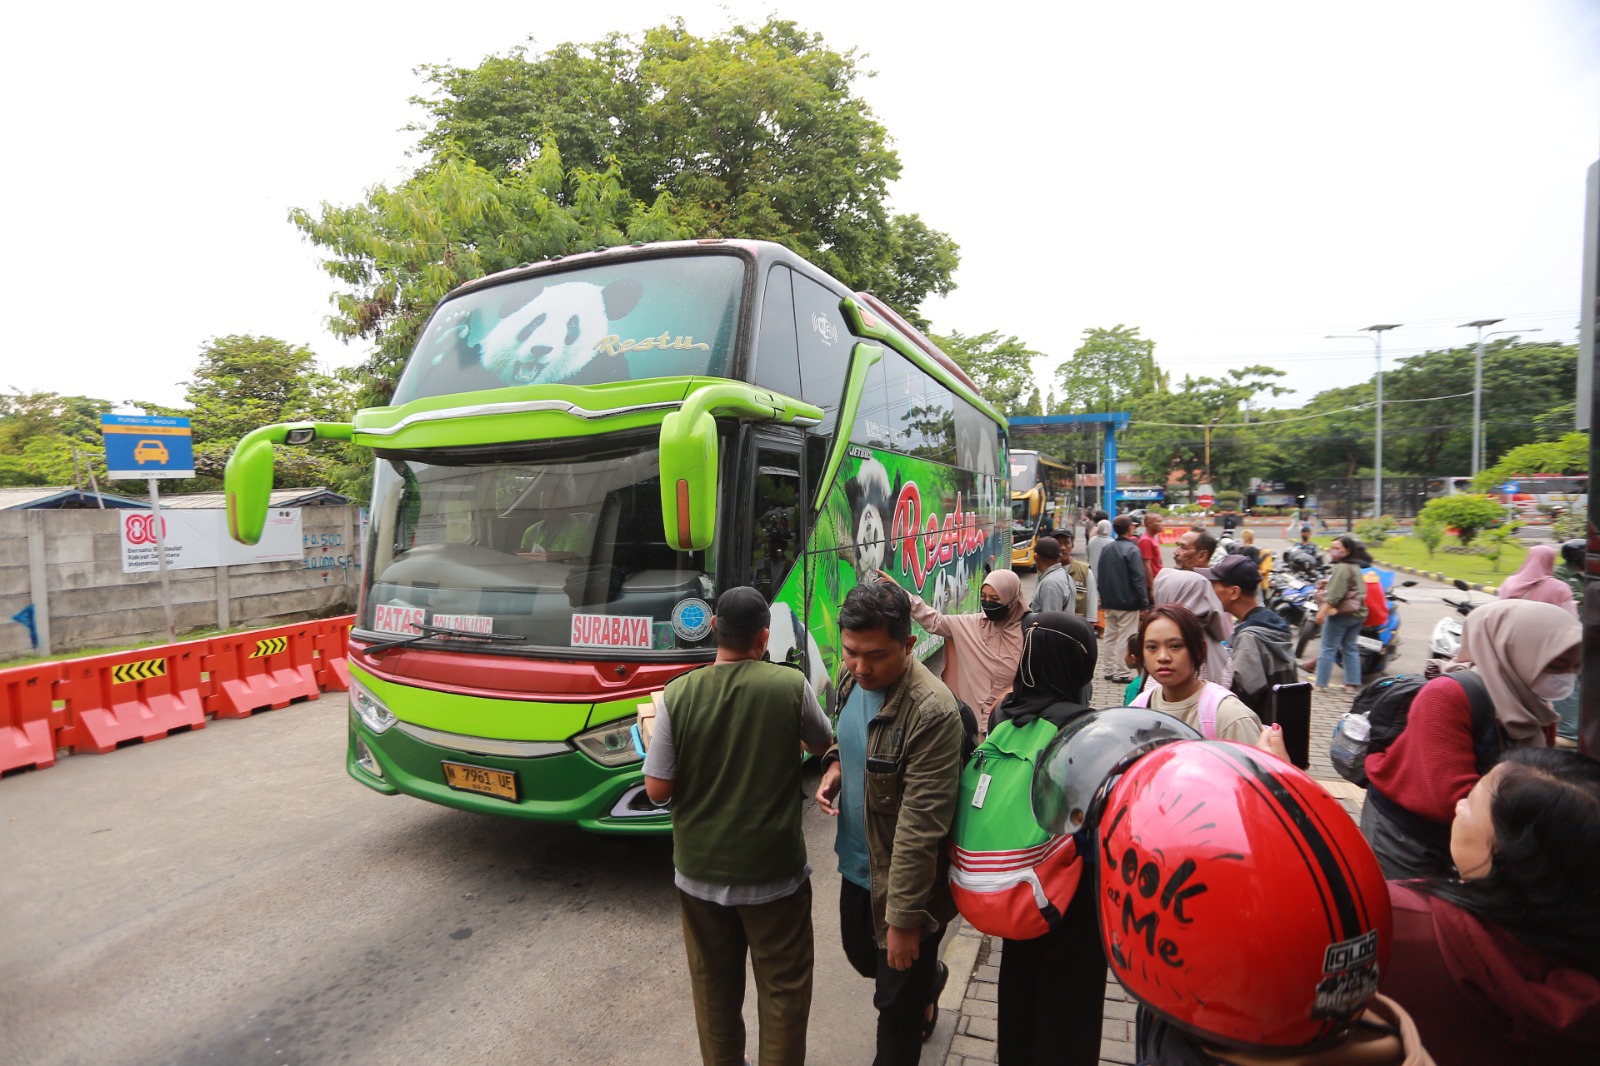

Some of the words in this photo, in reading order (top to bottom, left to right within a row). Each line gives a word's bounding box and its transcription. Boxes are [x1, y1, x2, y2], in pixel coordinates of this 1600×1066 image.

[593, 331, 710, 357] Restu
[849, 446, 873, 459] JETBUS
[890, 480, 985, 593] Restu
[376, 606, 424, 636] PATAS
[572, 615, 650, 647] SURABAYA
[463, 768, 492, 785] 7961
[498, 774, 513, 790] UE
[1106, 886, 1121, 907] at
[1122, 891, 1185, 968] Me
